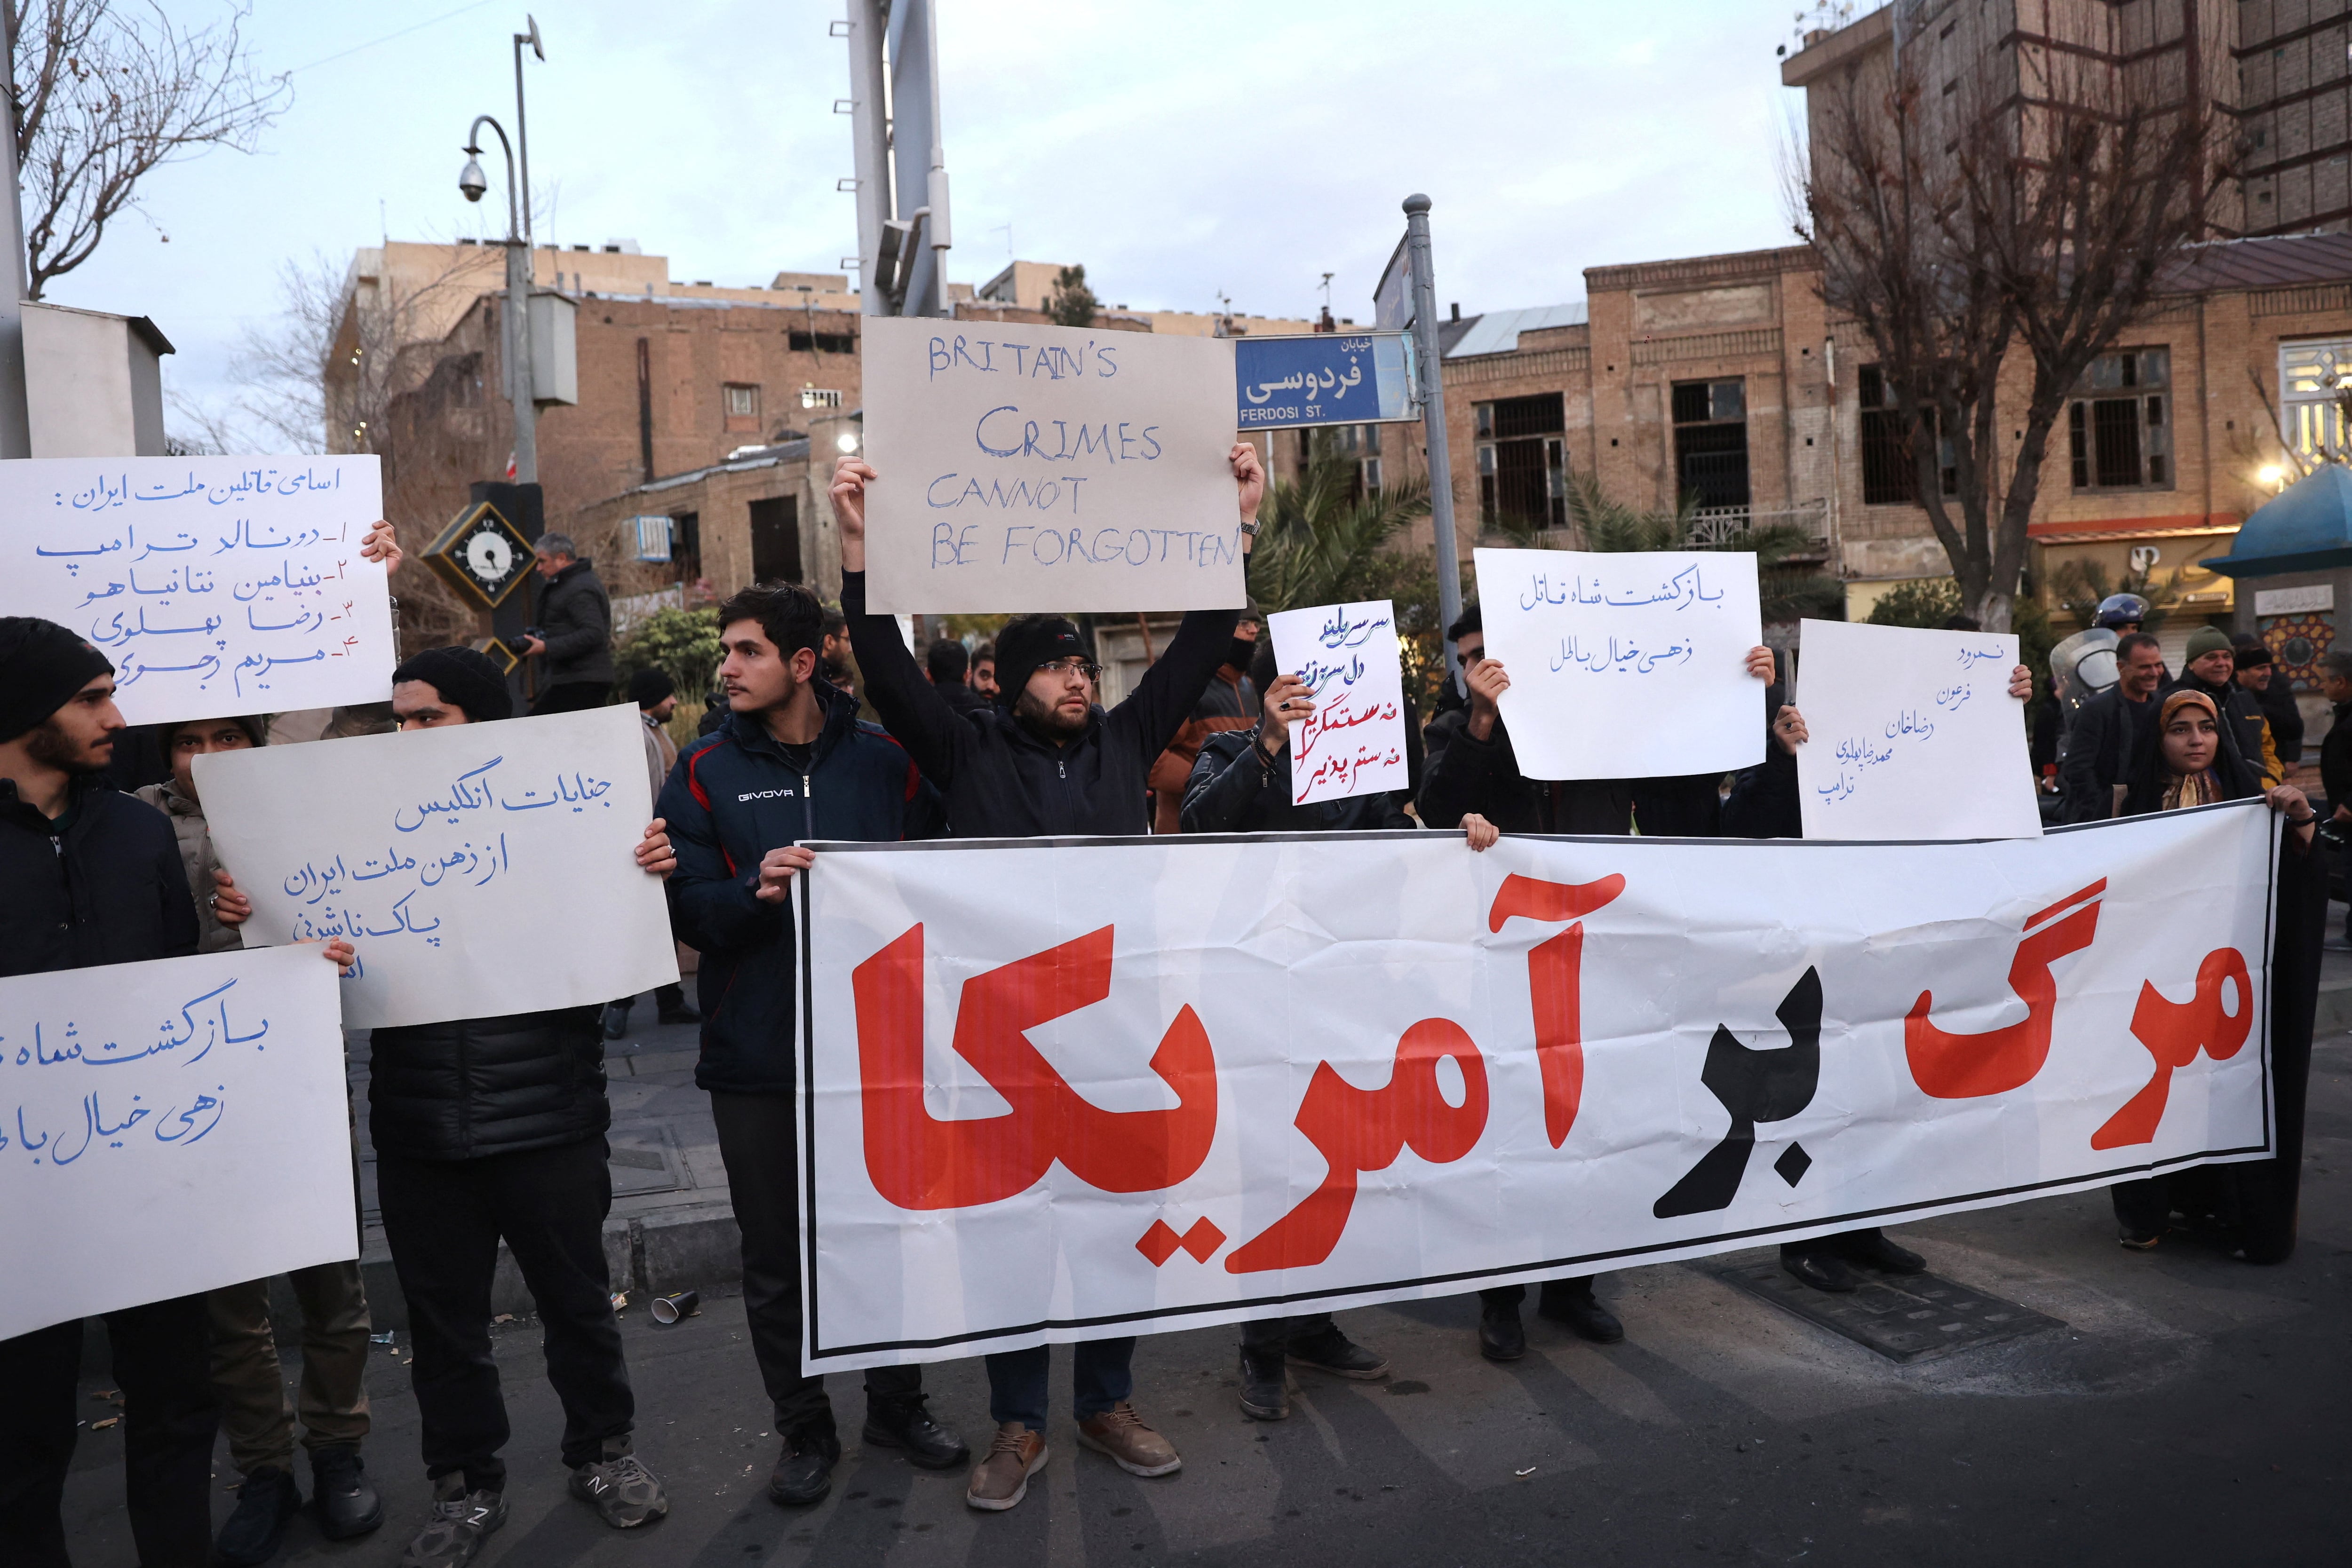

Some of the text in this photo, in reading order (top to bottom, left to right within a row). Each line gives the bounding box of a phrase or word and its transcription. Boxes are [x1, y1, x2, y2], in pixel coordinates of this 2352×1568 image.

[930, 335, 1118, 382] BRITAIN'S
[1341, 338, 1371, 352] خیابان
[1246, 356, 1361, 404] فردوسی
[1240, 405, 1326, 422] FERDOSI ST.
[976, 405, 1161, 464] CRIMES
[135, 472, 206, 501] ملت
[207, 469, 278, 507] قاتلین
[277, 467, 340, 496] اسامی
[927, 473, 1088, 514] CANNOT
[36, 524, 199, 577] ترامپ
[210, 519, 320, 555] دونالد
[931, 523, 1241, 569] BE FORGOTTEN
[75, 564, 215, 609] نتانیاهو
[233, 560, 322, 602] بنیامین
[1520, 573, 1566, 611] قاتل
[1572, 575, 1601, 604] شاه
[91, 605, 227, 651] پهلوی
[248, 605, 324, 634] رضا
[114, 652, 221, 689] رجوی
[234, 649, 326, 697] مریم
[1343, 653, 1365, 686] دل
[1550, 635, 1591, 673] باطل
[1591, 635, 1640, 673] خیال
[1957, 644, 2004, 670] نمرود
[1379, 702, 1397, 721] نه
[1936, 683, 1971, 711] فرعون
[1383, 747, 1400, 768] نه
[1836, 736, 1863, 772] پهلوی
[394, 755, 612, 833] جنایات انگلیس
[738, 789, 794, 802] GIVOVA
[1818, 772, 1854, 805] ترامپ
[284, 833, 509, 905] از ذهن ملت ایران
[366, 888, 441, 947] پاک
[16, 1022, 83, 1066] شاه
[850, 871, 2254, 1275] مرگ بر آمریکا
[52, 1091, 151, 1166] خیال
[155, 1084, 225, 1146] زهی
